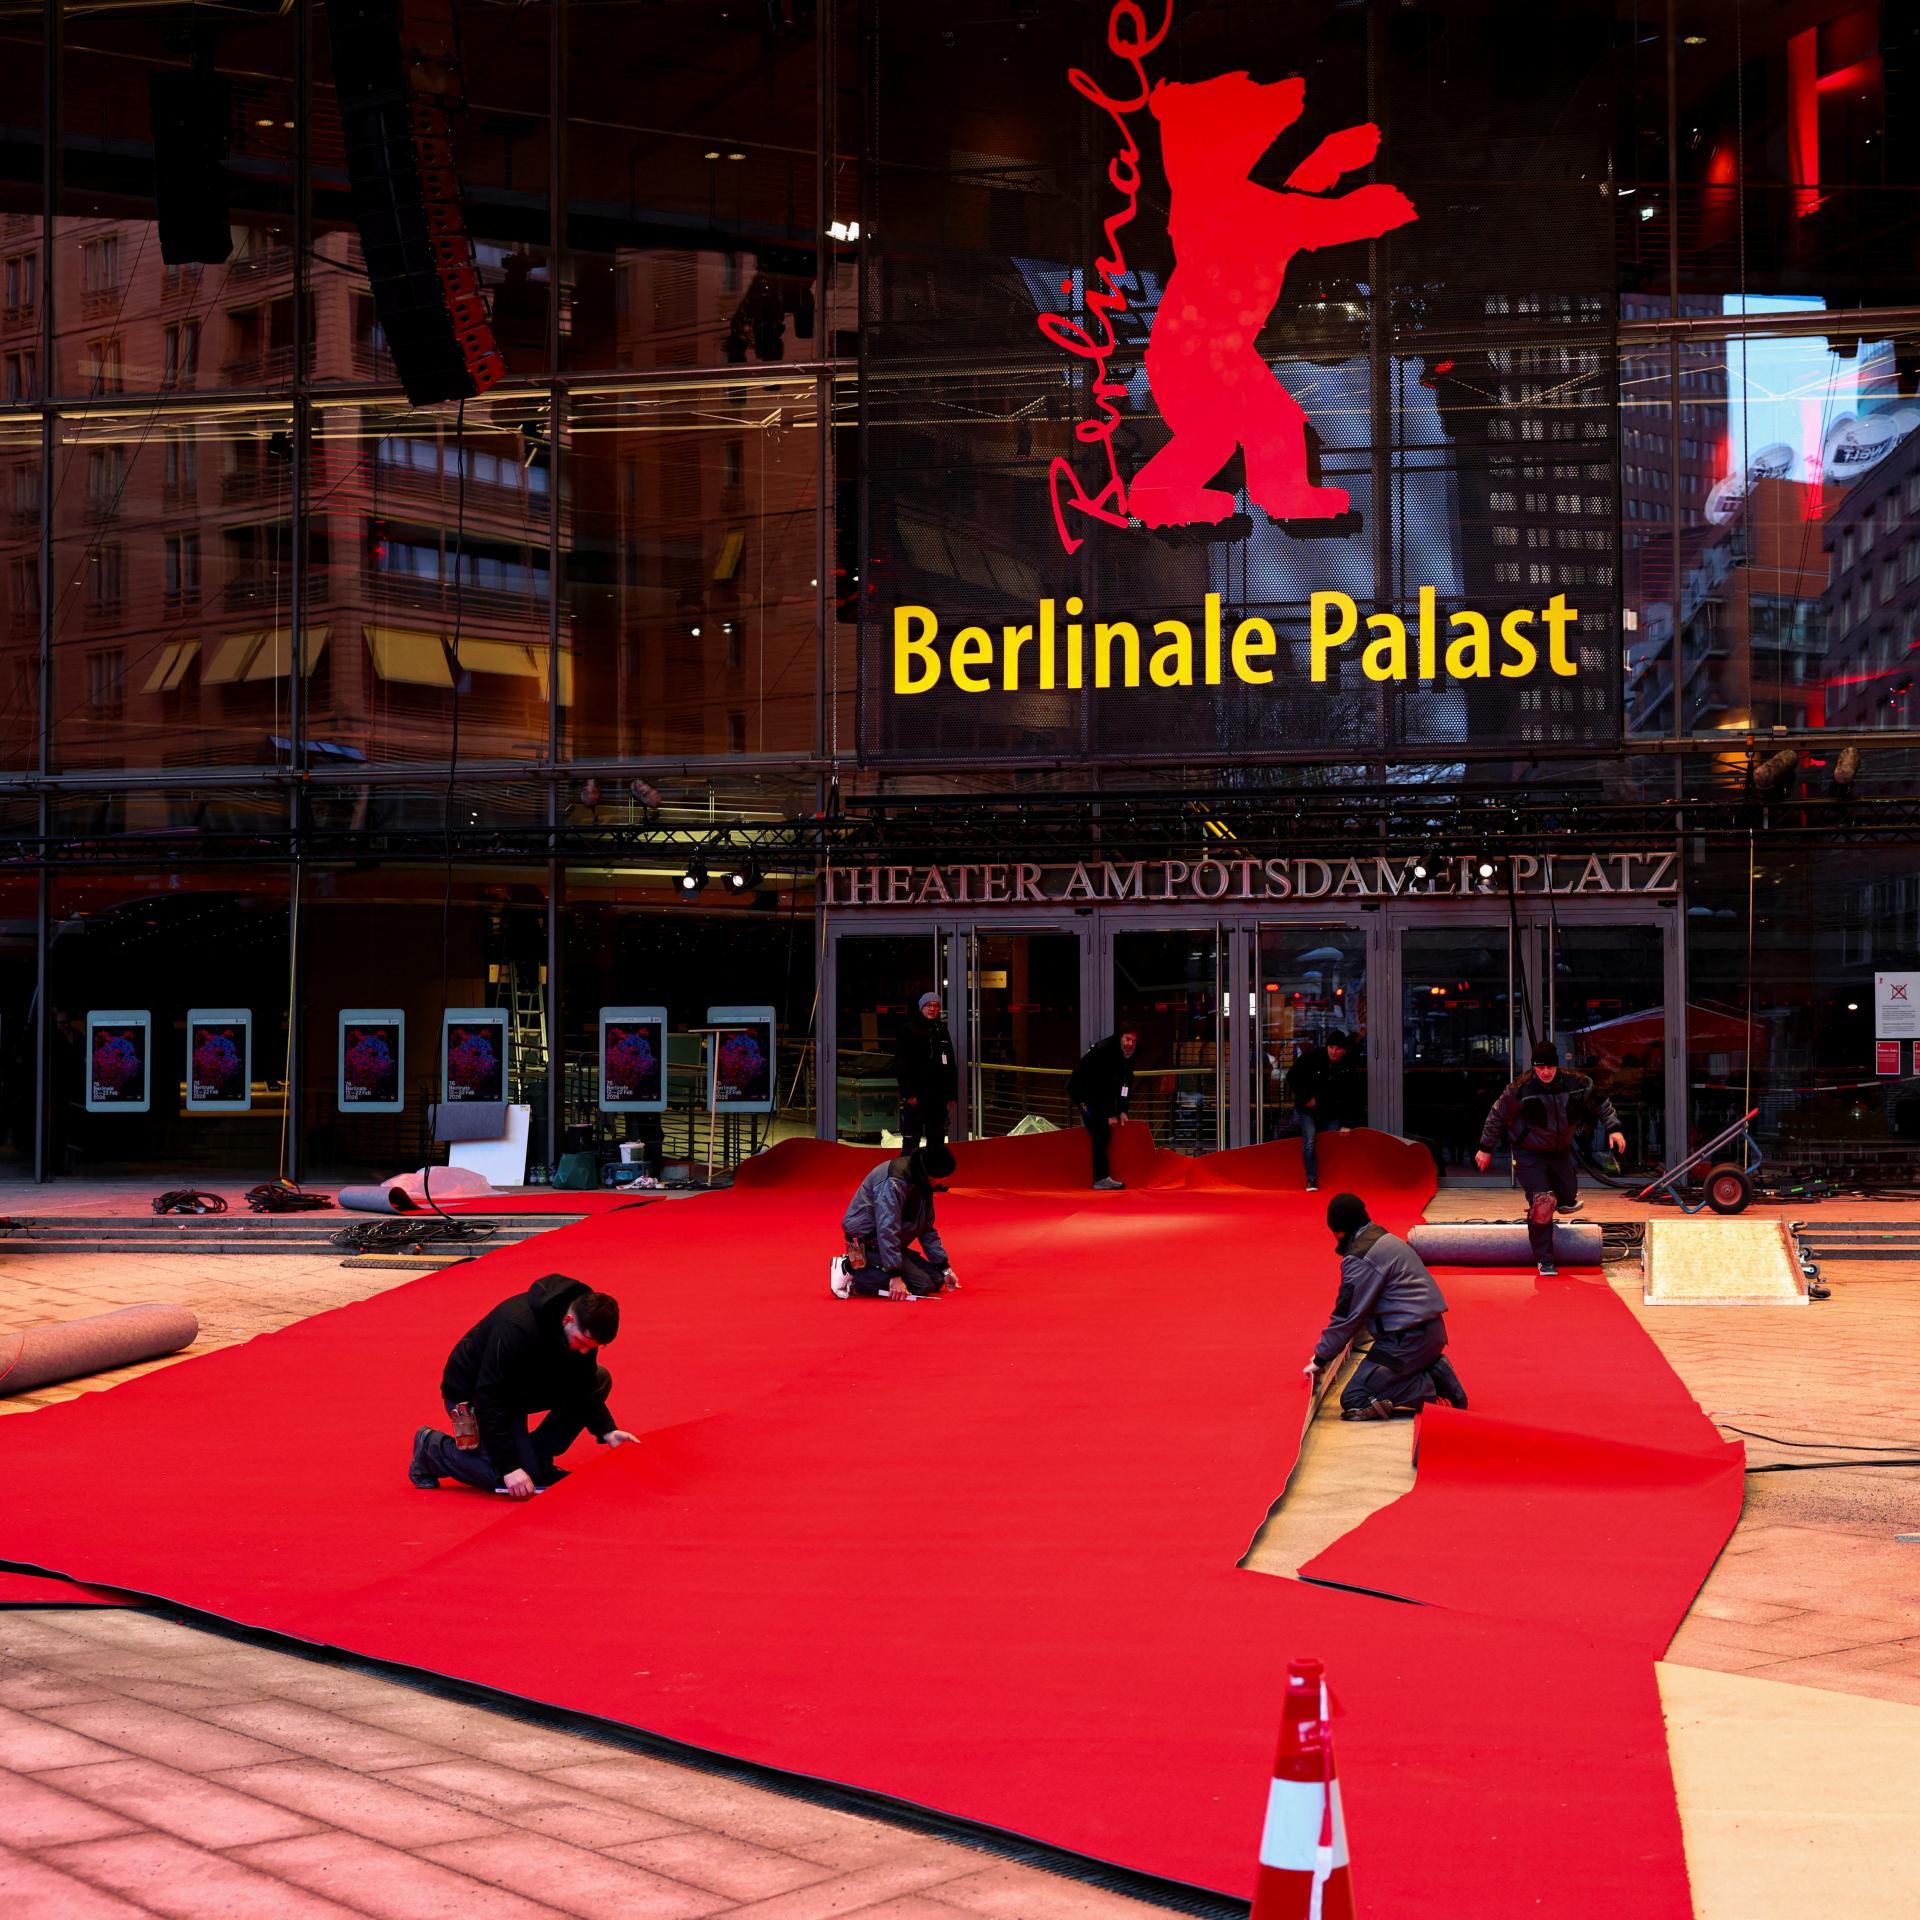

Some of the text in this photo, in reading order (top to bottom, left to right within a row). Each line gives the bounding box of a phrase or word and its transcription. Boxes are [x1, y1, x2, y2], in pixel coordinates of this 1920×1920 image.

[1038, 0, 1174, 554] Berlinale
[895, 586, 1578, 695] Berlinale Palast
[816, 862, 1046, 904] THEATER
[1065, 860, 1147, 901] AM
[1508, 852, 1679, 894] PLATZ
